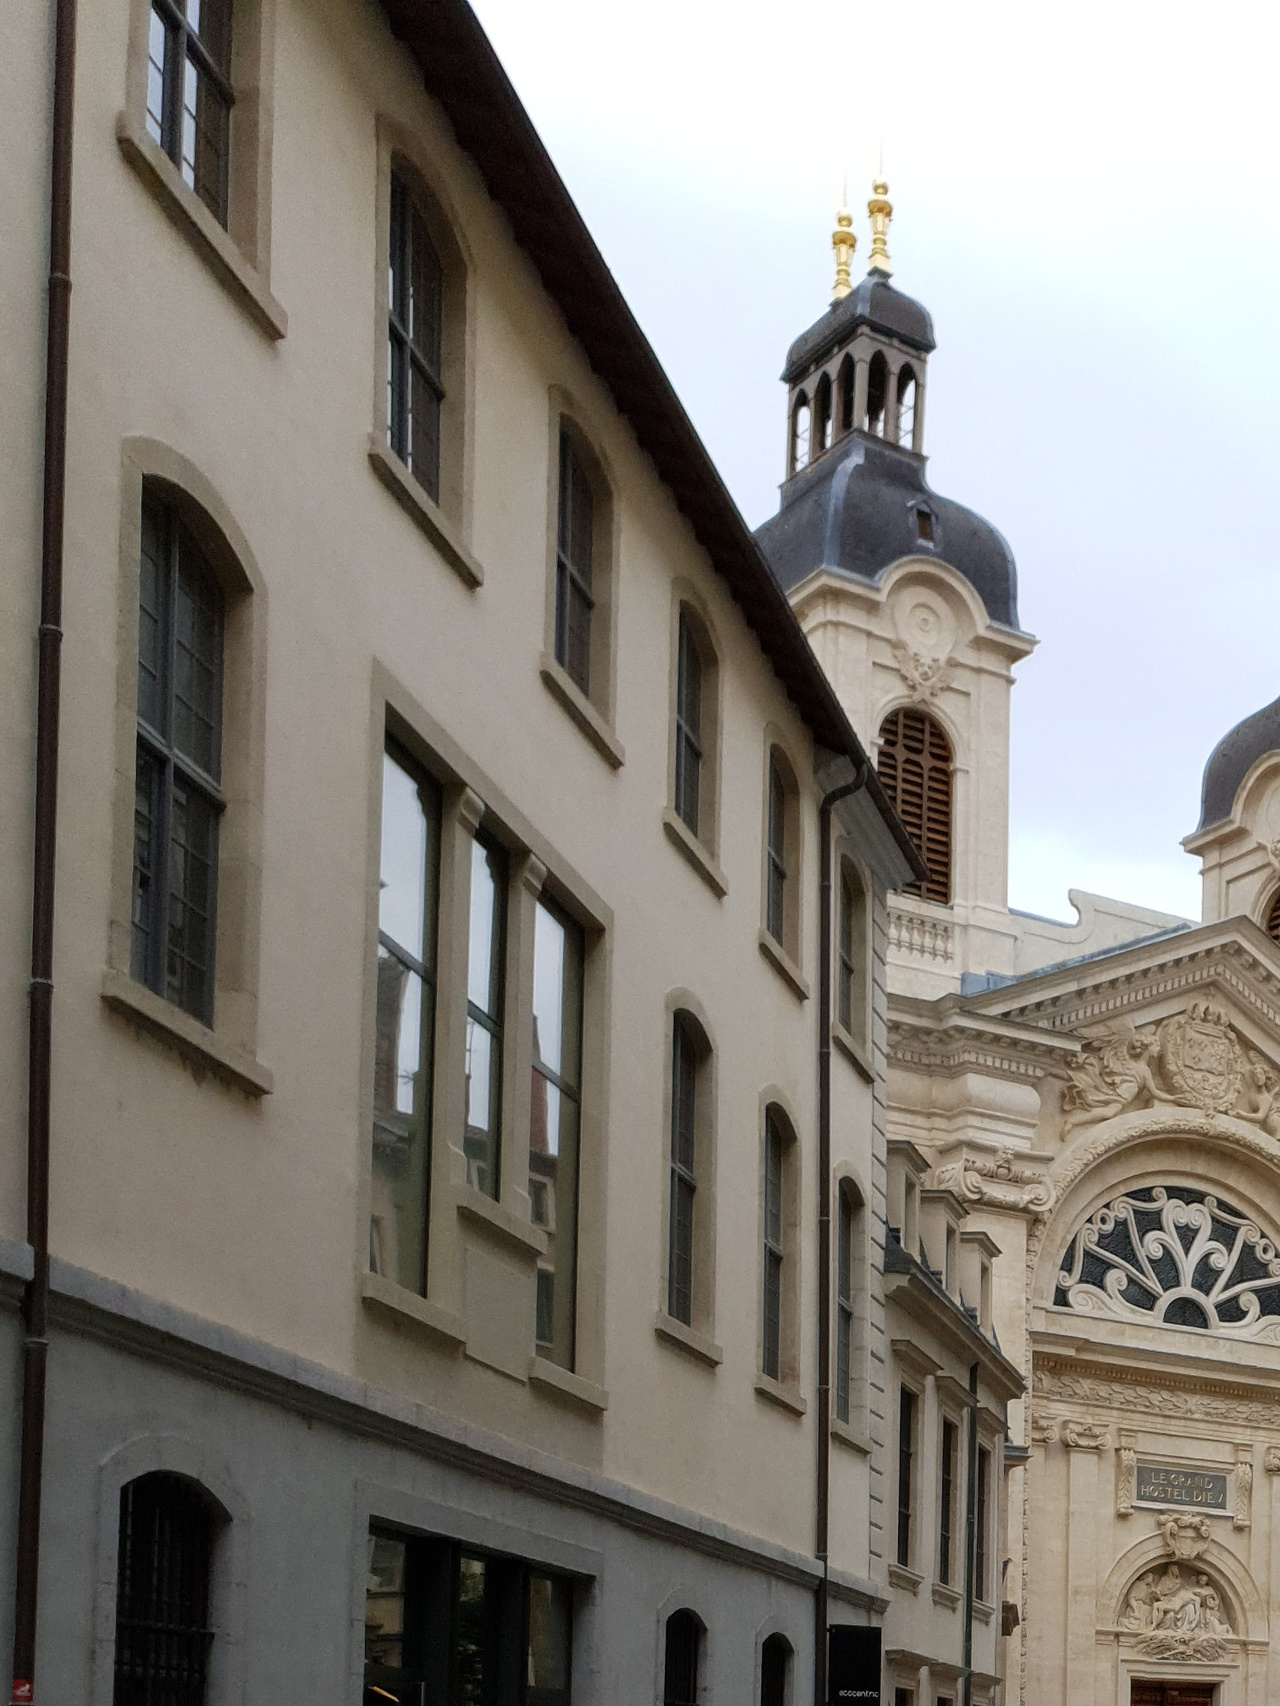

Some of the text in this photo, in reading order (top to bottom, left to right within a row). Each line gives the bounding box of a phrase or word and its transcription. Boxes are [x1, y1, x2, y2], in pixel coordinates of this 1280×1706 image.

[1151, 1471, 1167, 1483] LE
[1141, 1485, 1190, 1501] HOSTEL
[839, 1690, 879, 1698] ecocentric
